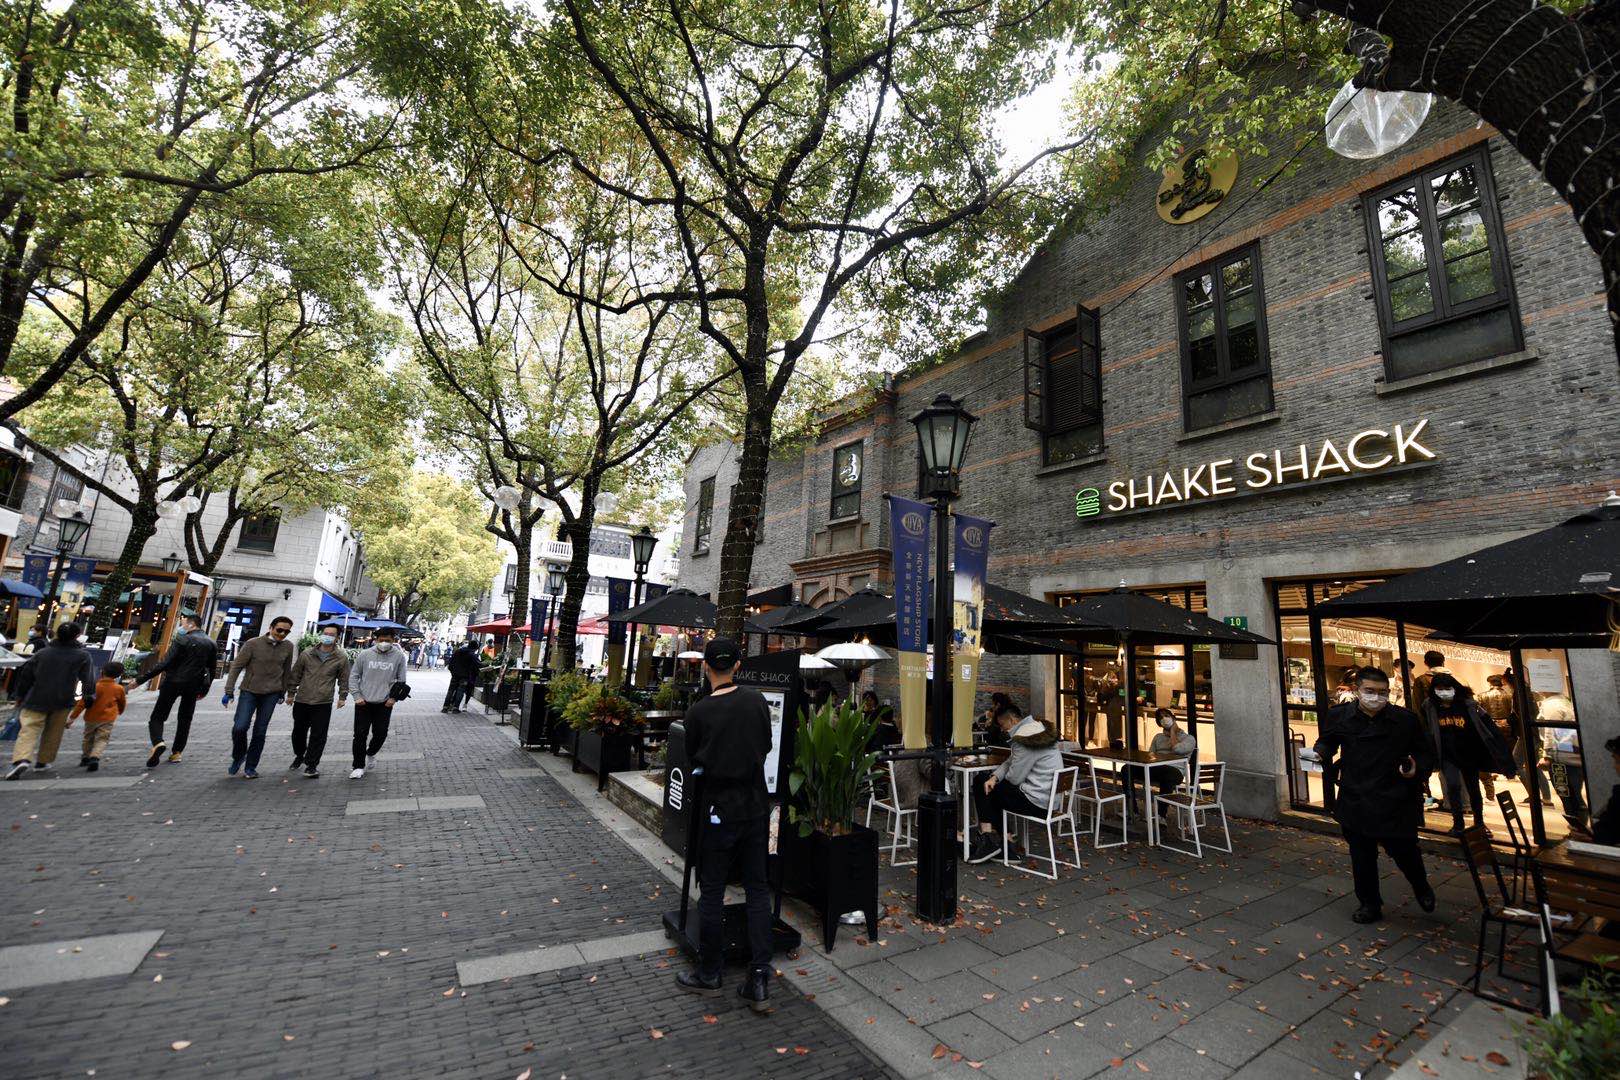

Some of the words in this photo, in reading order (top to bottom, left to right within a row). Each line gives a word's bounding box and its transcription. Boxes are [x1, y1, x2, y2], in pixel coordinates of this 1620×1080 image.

[1108, 458, 1236, 511] SHAKE
[1246, 419, 1436, 488] SHACK
[914, 576, 923, 617] FLAGSHIP
[1230, 617, 1241, 626] 10
[369, 661, 393, 671] NASA
[735, 671, 757, 681] HAKE
[760, 671, 791, 683] SHACK
